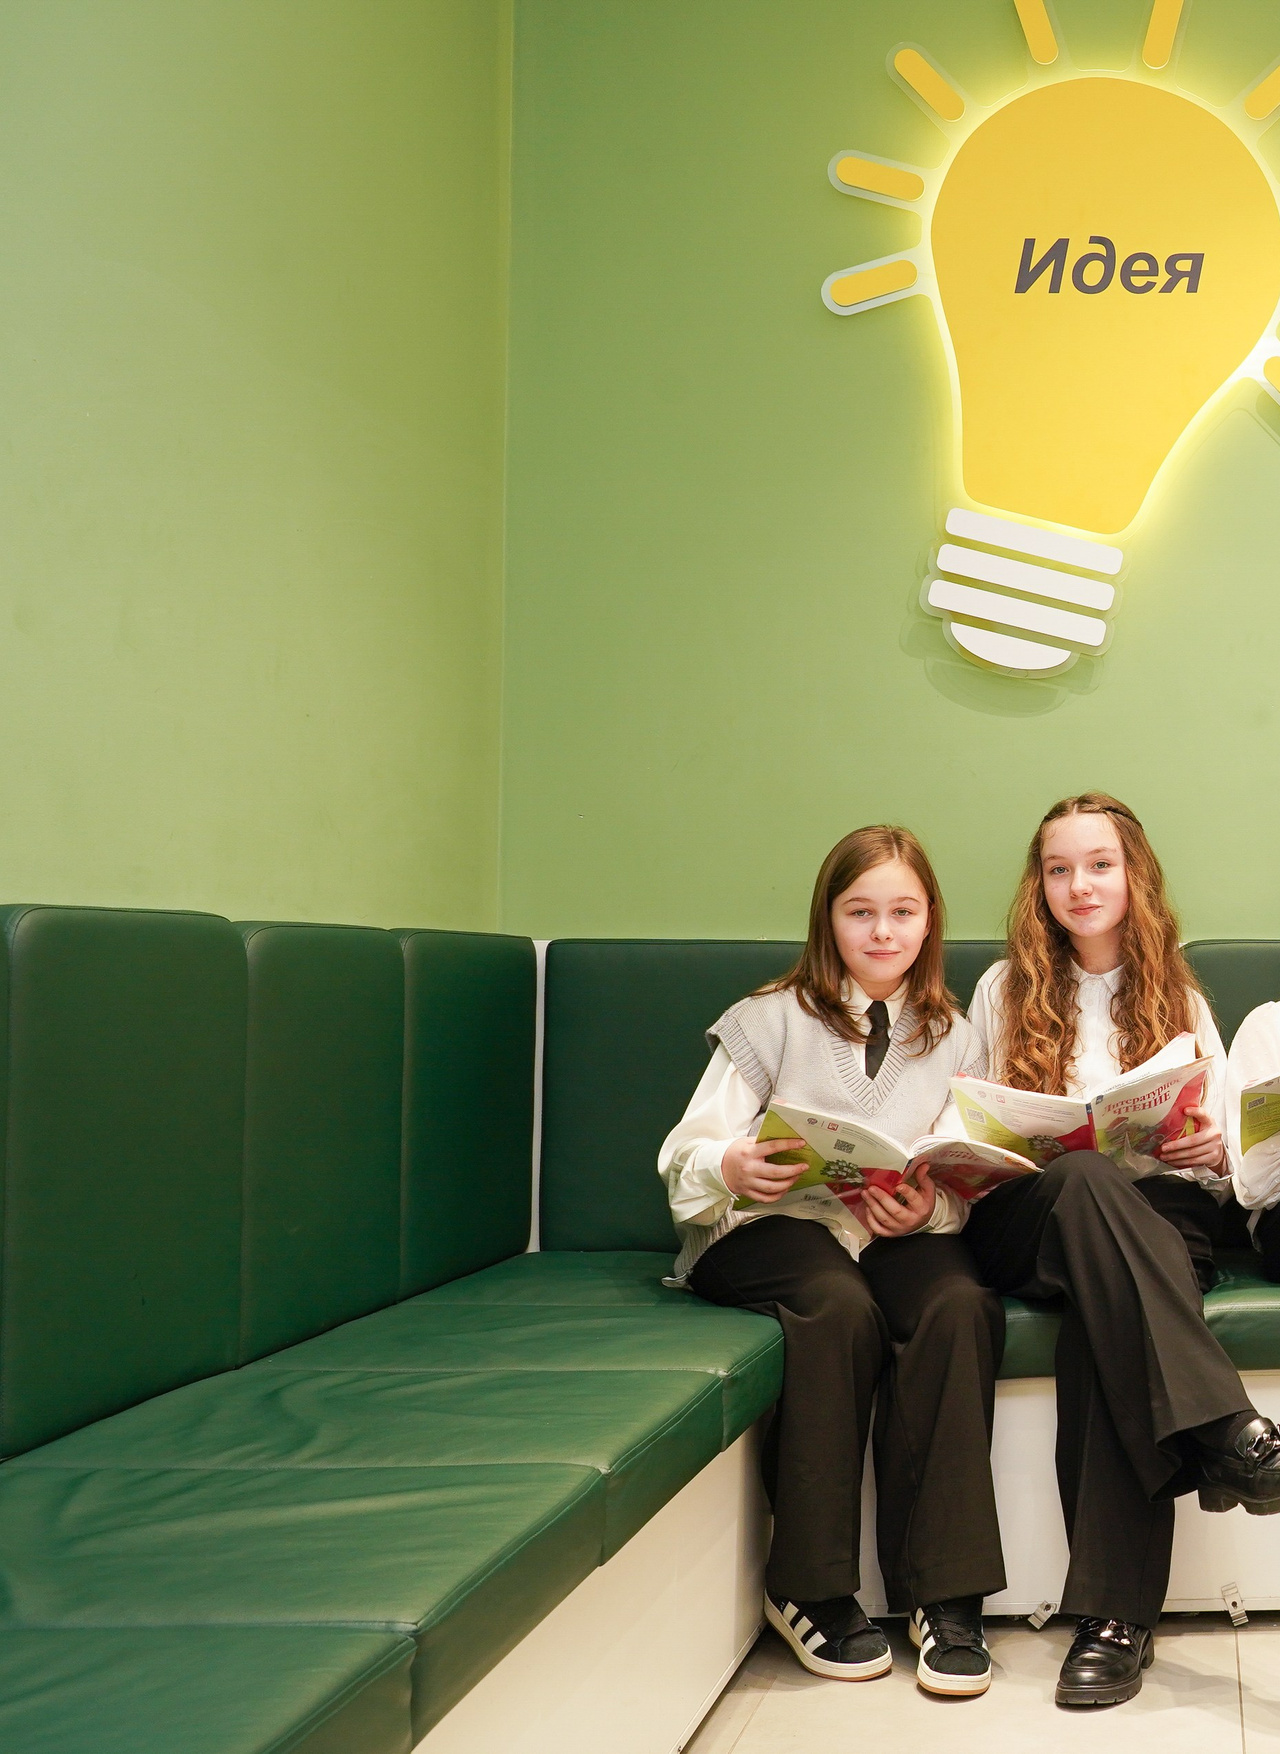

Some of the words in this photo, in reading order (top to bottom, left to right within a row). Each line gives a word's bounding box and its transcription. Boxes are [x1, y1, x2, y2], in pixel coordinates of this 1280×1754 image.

[1014, 235, 1205, 294] Идея
[1102, 1077, 1183, 1117] Литературное
[1113, 1091, 1171, 1115] ЧТЕНИЕ
